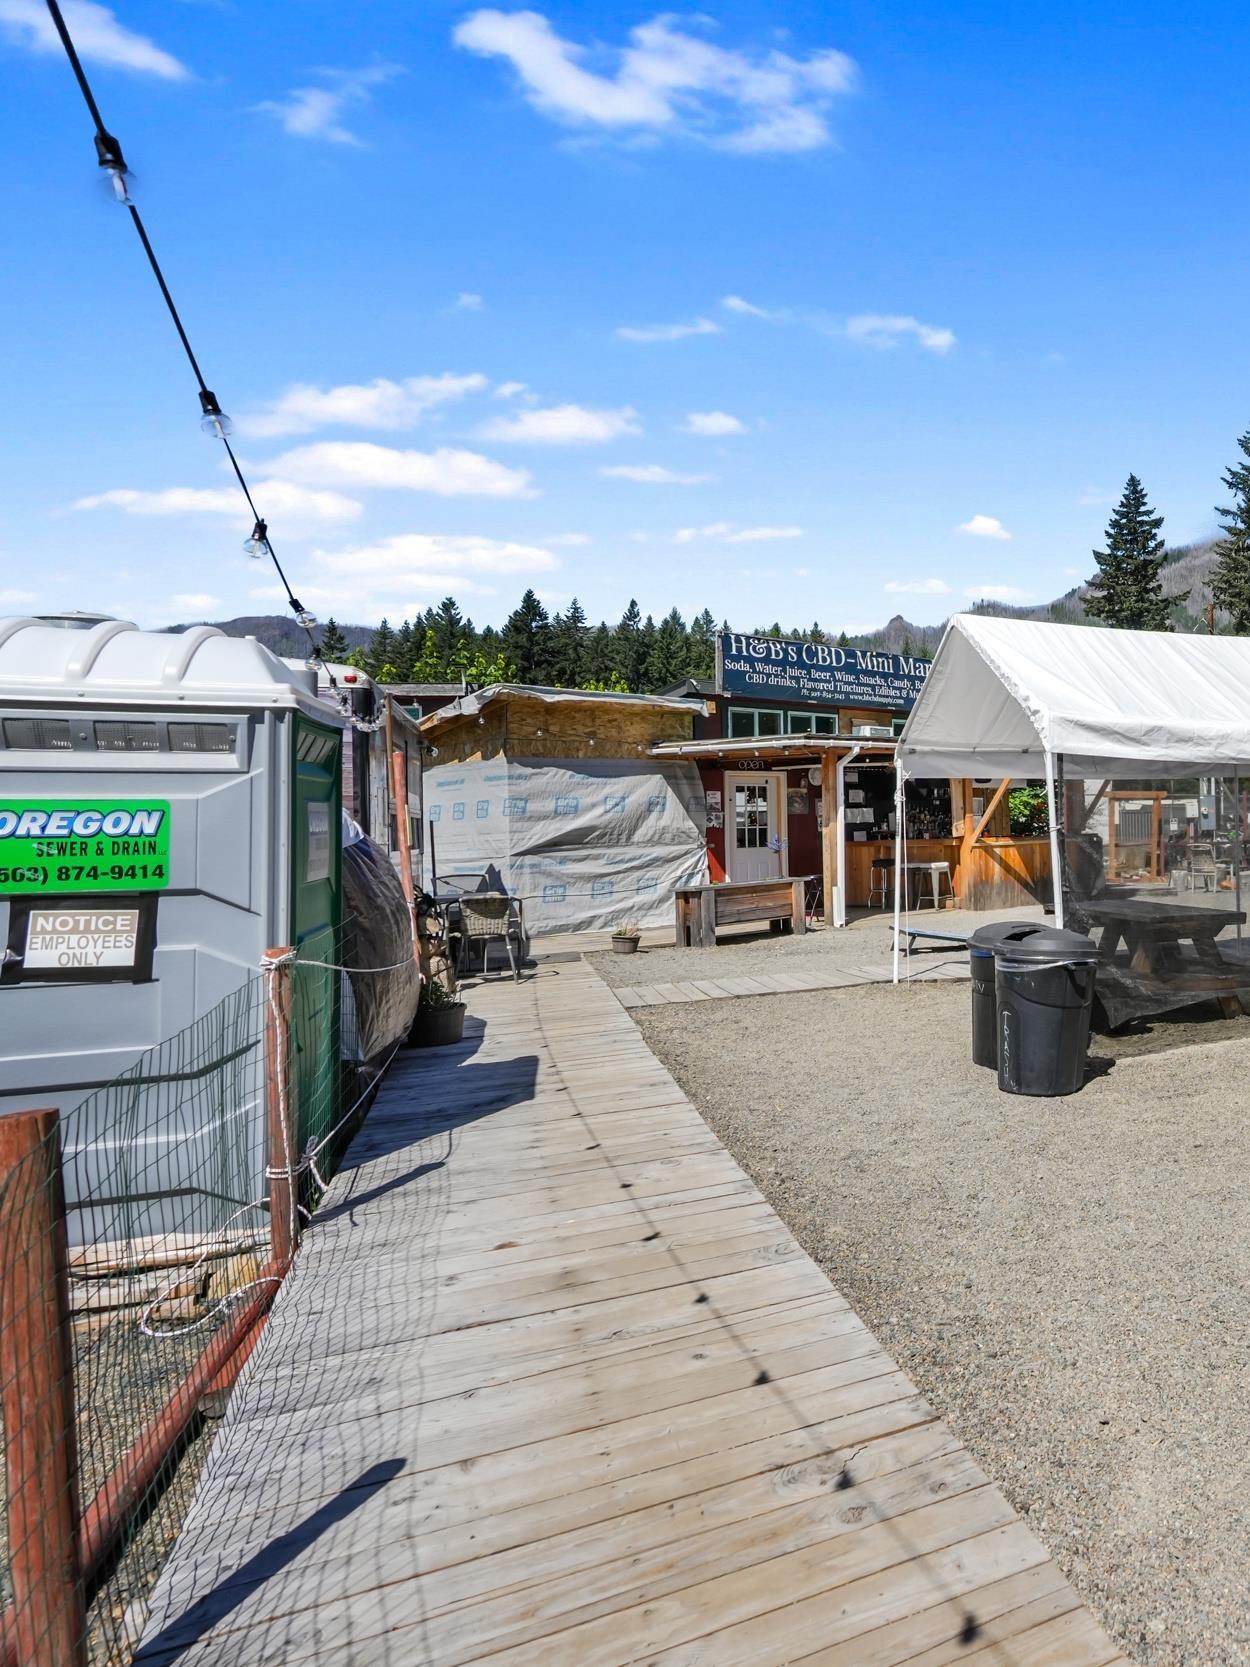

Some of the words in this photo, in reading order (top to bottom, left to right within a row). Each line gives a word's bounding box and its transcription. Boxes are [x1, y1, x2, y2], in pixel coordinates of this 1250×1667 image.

[728, 634, 797, 662] H&B's
[802, 643, 894, 673] CBD-Mini
[898, 656, 932, 676] Mar
[724, 659, 753, 673] Soda,
[754, 662, 784, 675] Water,
[785, 666, 809, 678] Juice,
[811, 669, 833, 680] Beer,
[834, 671, 858, 683] Wine,
[859, 674, 887, 686] Snacks,
[888, 677, 913, 690] Candy,
[746, 672, 767, 684] CBD
[768, 676, 798, 688] drinks,
[800, 678, 834, 691] Flavored
[836, 682, 874, 694] Tinctures,
[875, 686, 900, 697] Edibles
[901, 689, 908, 698] &
[738, 759, 764, 771] open
[0, 809, 166, 838] OREGON
[36, 841, 89, 857] SEWER
[95, 841, 105, 857] &
[112, 840, 158, 857] DRAIN
[0, 866, 48, 885] 503)
[56, 864, 165, 881] 874-9414
[36, 915, 133, 932] NOTICE
[28, 934, 135, 951] EMPLOYEES
[58, 952, 104, 967] ONLY
